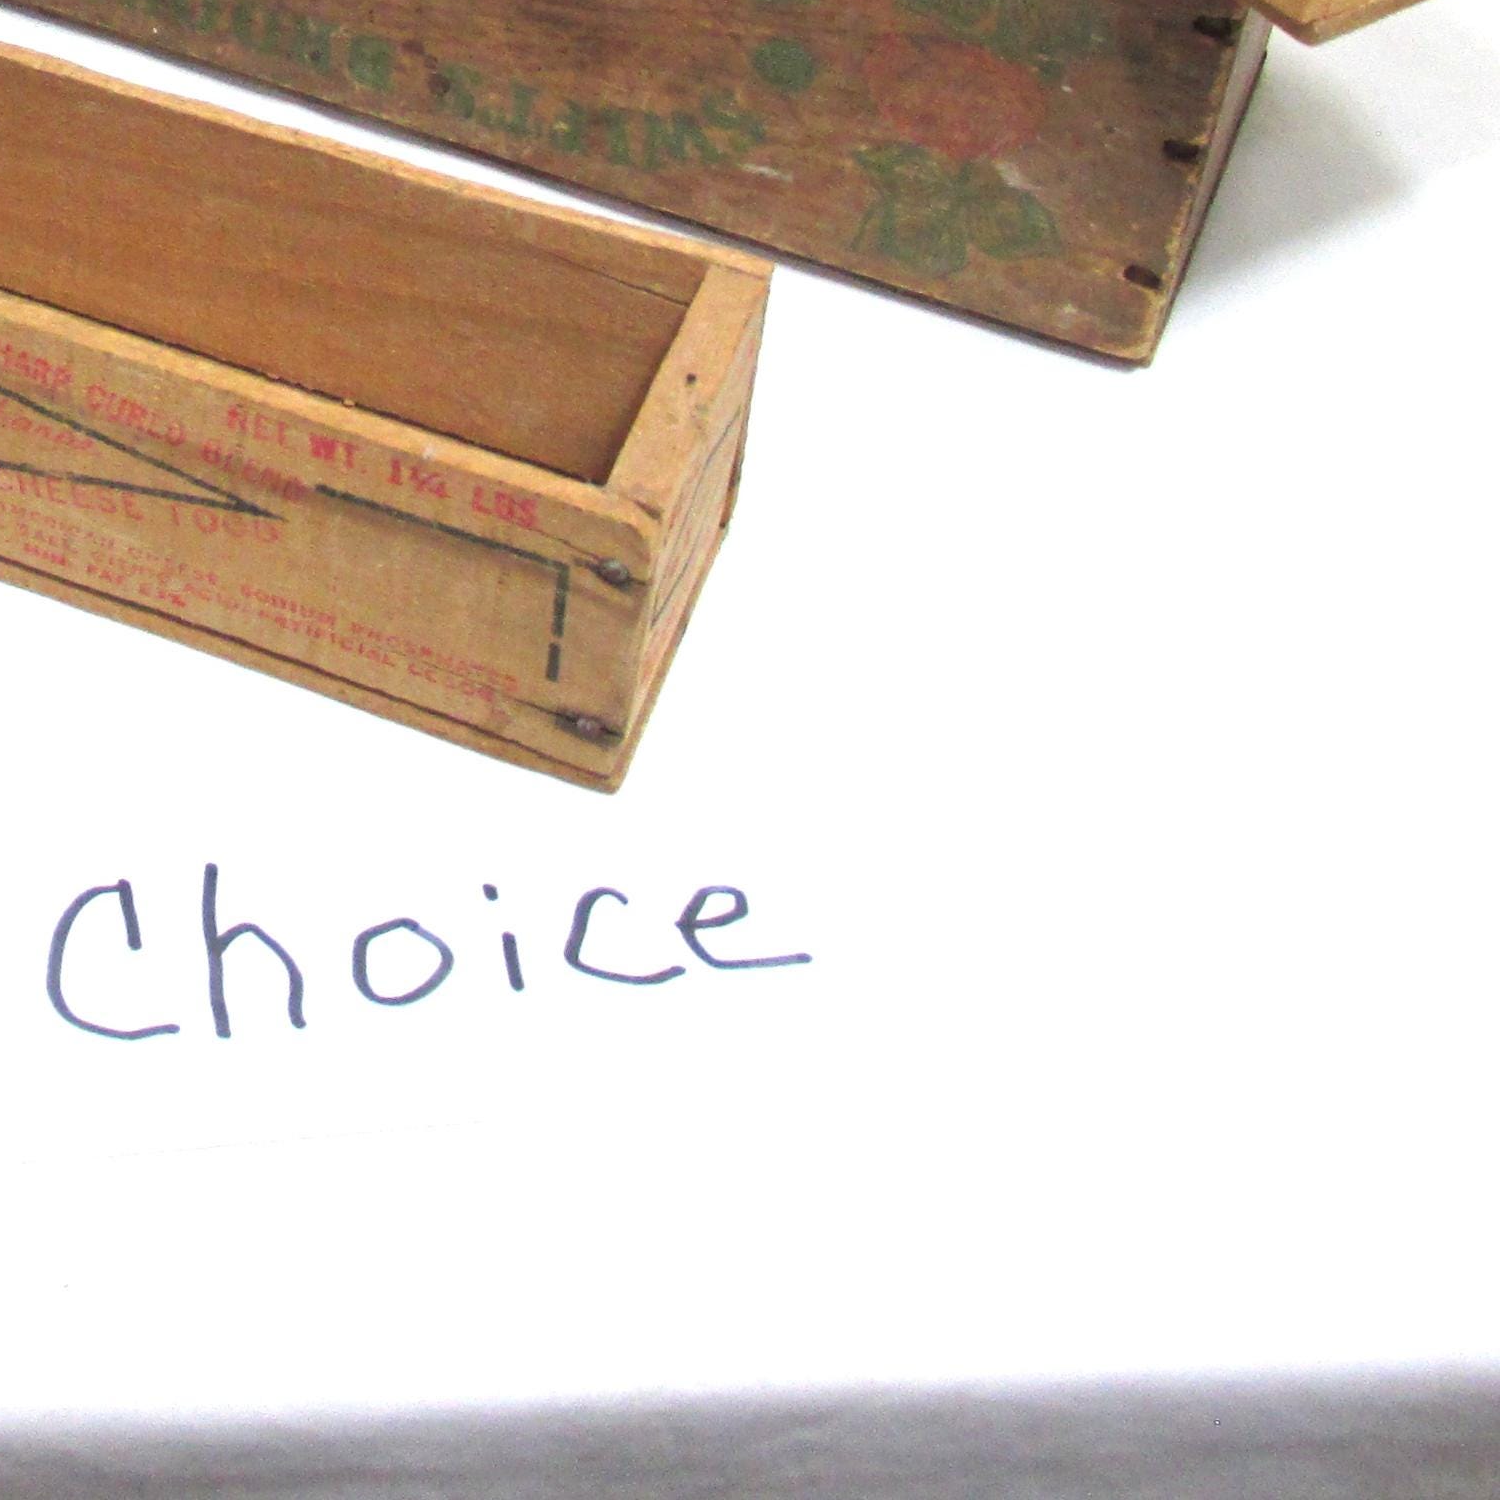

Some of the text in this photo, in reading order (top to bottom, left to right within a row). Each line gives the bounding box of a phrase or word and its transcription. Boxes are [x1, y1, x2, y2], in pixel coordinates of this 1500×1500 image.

[226, 403, 289, 448] NET
[308, 433, 368, 476] WT.
[45, 861, 814, 1041] Choice
